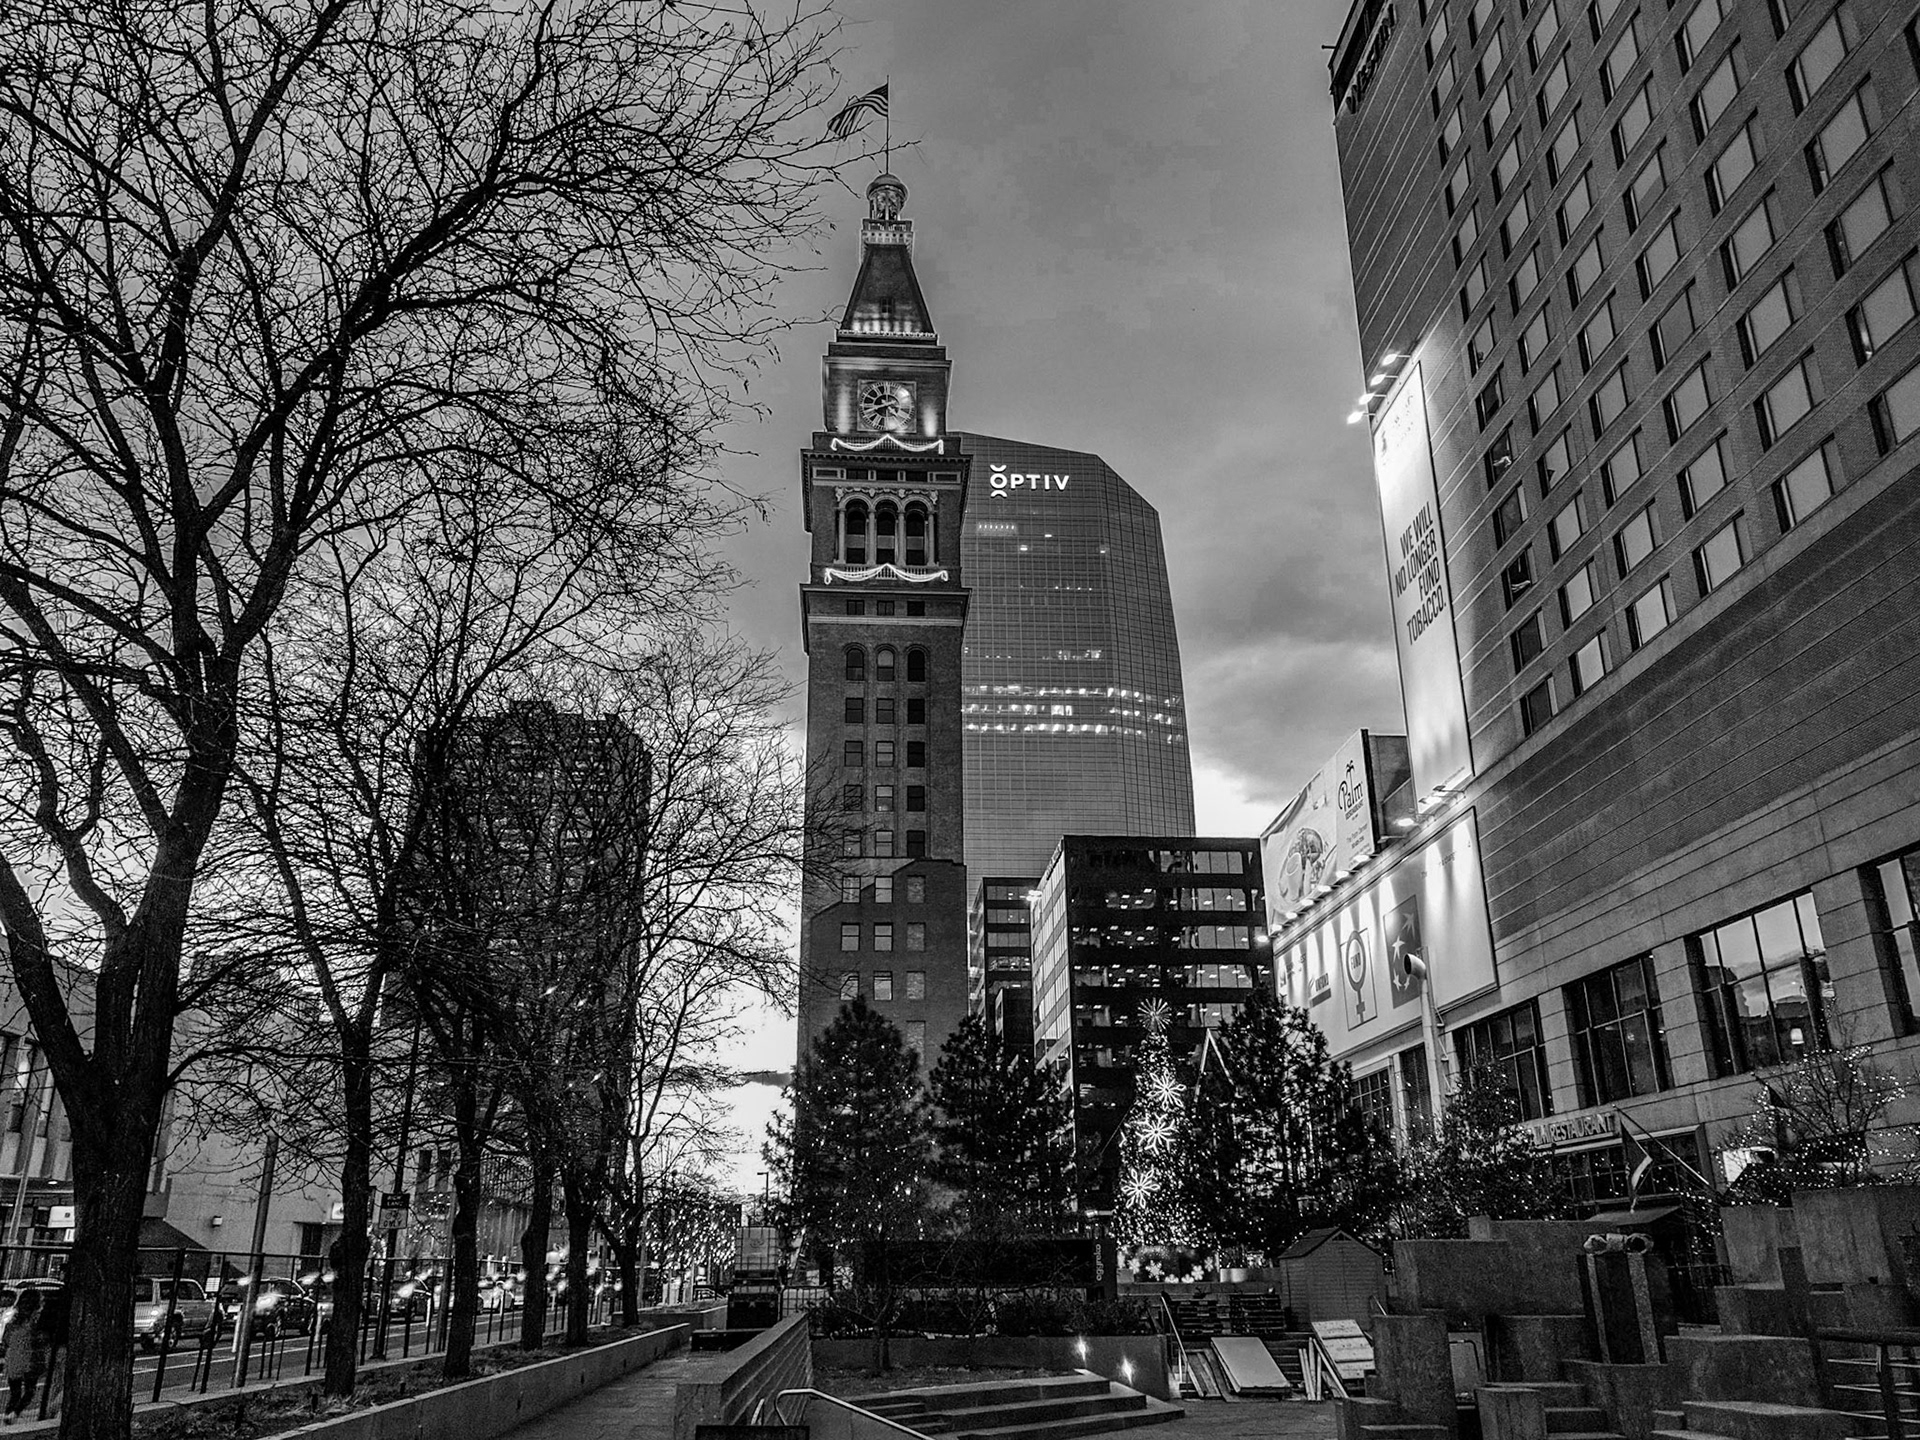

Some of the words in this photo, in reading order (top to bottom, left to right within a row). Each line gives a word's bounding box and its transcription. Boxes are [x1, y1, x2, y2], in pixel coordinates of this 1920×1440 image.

[989, 468, 1069, 494] OPTIV
[1400, 525, 1413, 558] WE
[1413, 501, 1433, 543] WILL
[1395, 565, 1407, 598] NO
[1406, 528, 1437, 585] LONGER
[1418, 556, 1440, 601] FUND
[1406, 585, 1447, 646] TOBACCO.
[1337, 760, 1364, 812] Palm
[1549, 1113, 1612, 1142] RESTAURANT
